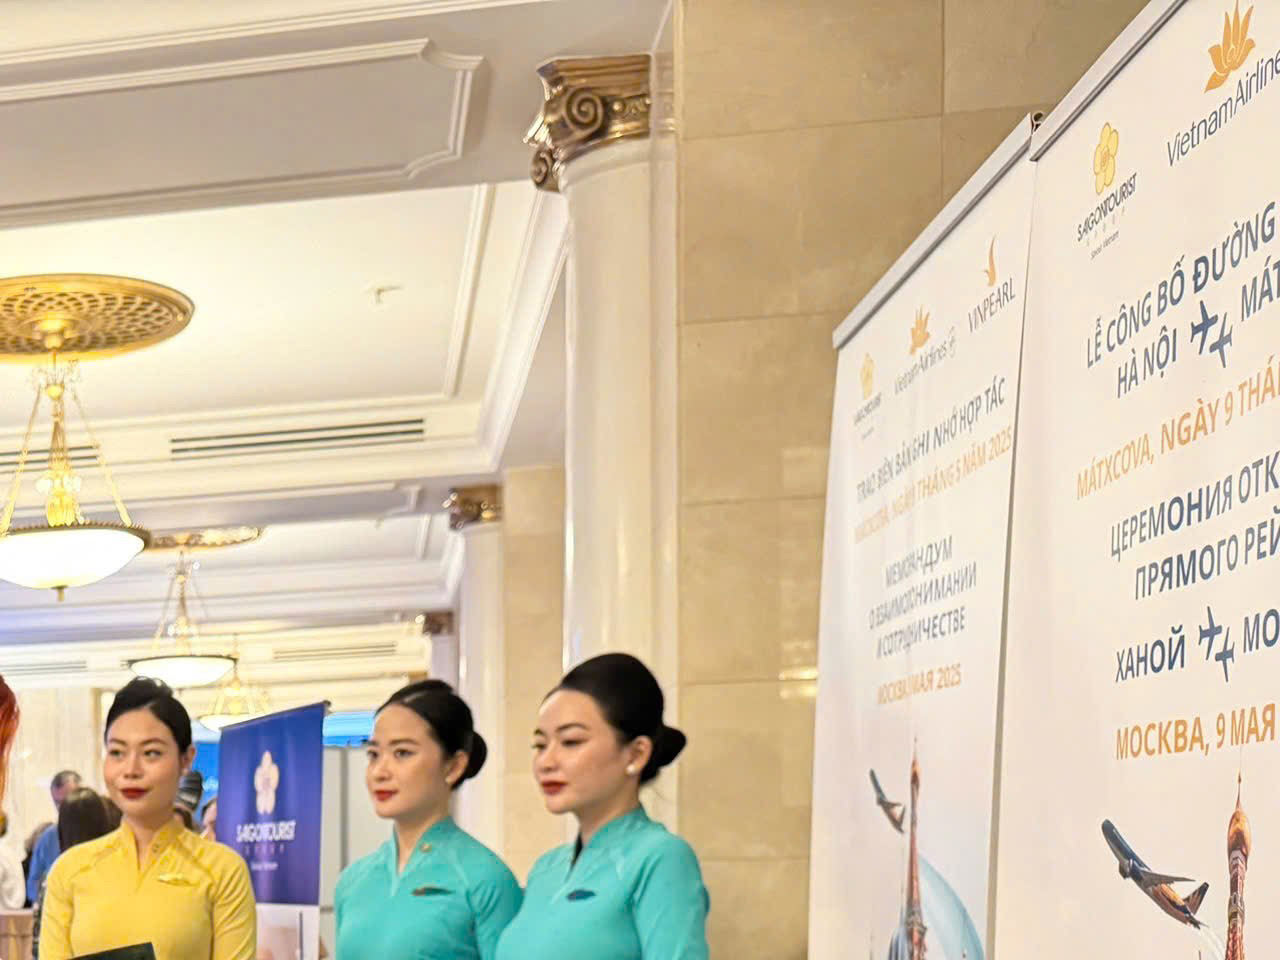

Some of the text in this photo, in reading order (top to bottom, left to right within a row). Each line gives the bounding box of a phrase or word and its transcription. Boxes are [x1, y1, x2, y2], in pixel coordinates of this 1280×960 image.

[1167, 96, 1233, 167] Vietnam
[1077, 172, 1137, 242] SAIGONTOURIST
[968, 277, 1016, 333] VINPEARL
[1087, 315, 1102, 368] LỄ
[1106, 291, 1152, 353] CÔNG
[1157, 254, 1185, 317] BỐ
[1192, 201, 1276, 294] ĐƯỜNG
[984, 375, 1006, 415] TÁC
[1117, 347, 1139, 399] HÀ
[1143, 325, 1177, 380] NỘI
[1161, 398, 1220, 455] NGÀY
[1224, 391, 1234, 426] 9
[1237, 353, 1280, 416] THÁ
[1111, 474, 1233, 562] ЦЕРЕМОНИЯ
[1135, 534, 1239, 601] ПРЯМОГО
[1115, 624, 1185, 683] ХАНОЙ
[1116, 703, 1276, 761] МОСКВА, 9 МАЯ
